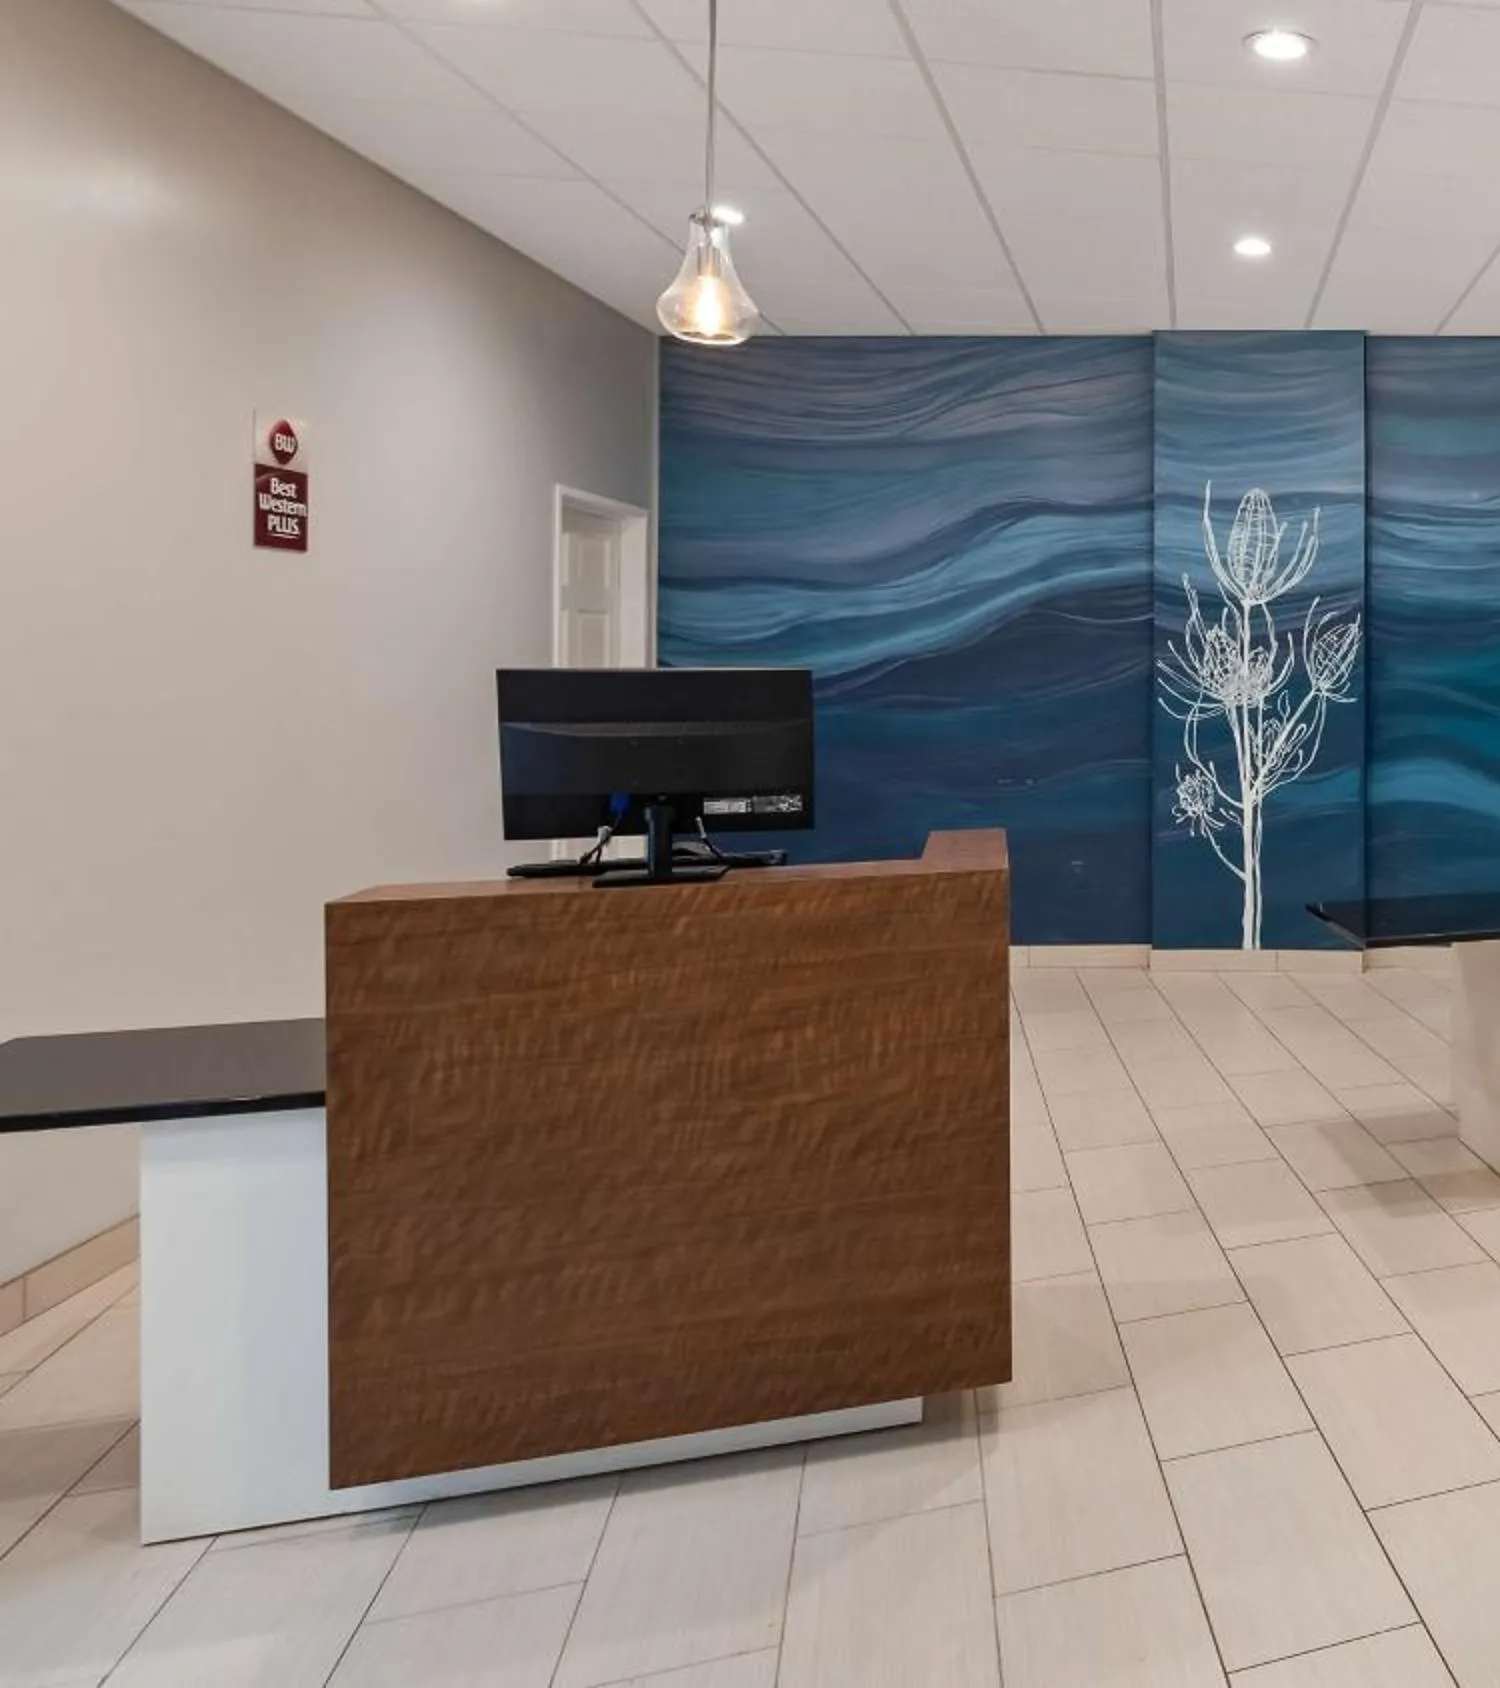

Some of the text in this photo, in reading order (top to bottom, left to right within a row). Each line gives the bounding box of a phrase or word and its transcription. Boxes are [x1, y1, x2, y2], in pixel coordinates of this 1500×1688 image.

[274, 432, 296, 453] BW
[270, 477, 297, 498] Best
[259, 493, 307, 517] Western
[267, 514, 300, 534] PLUS
